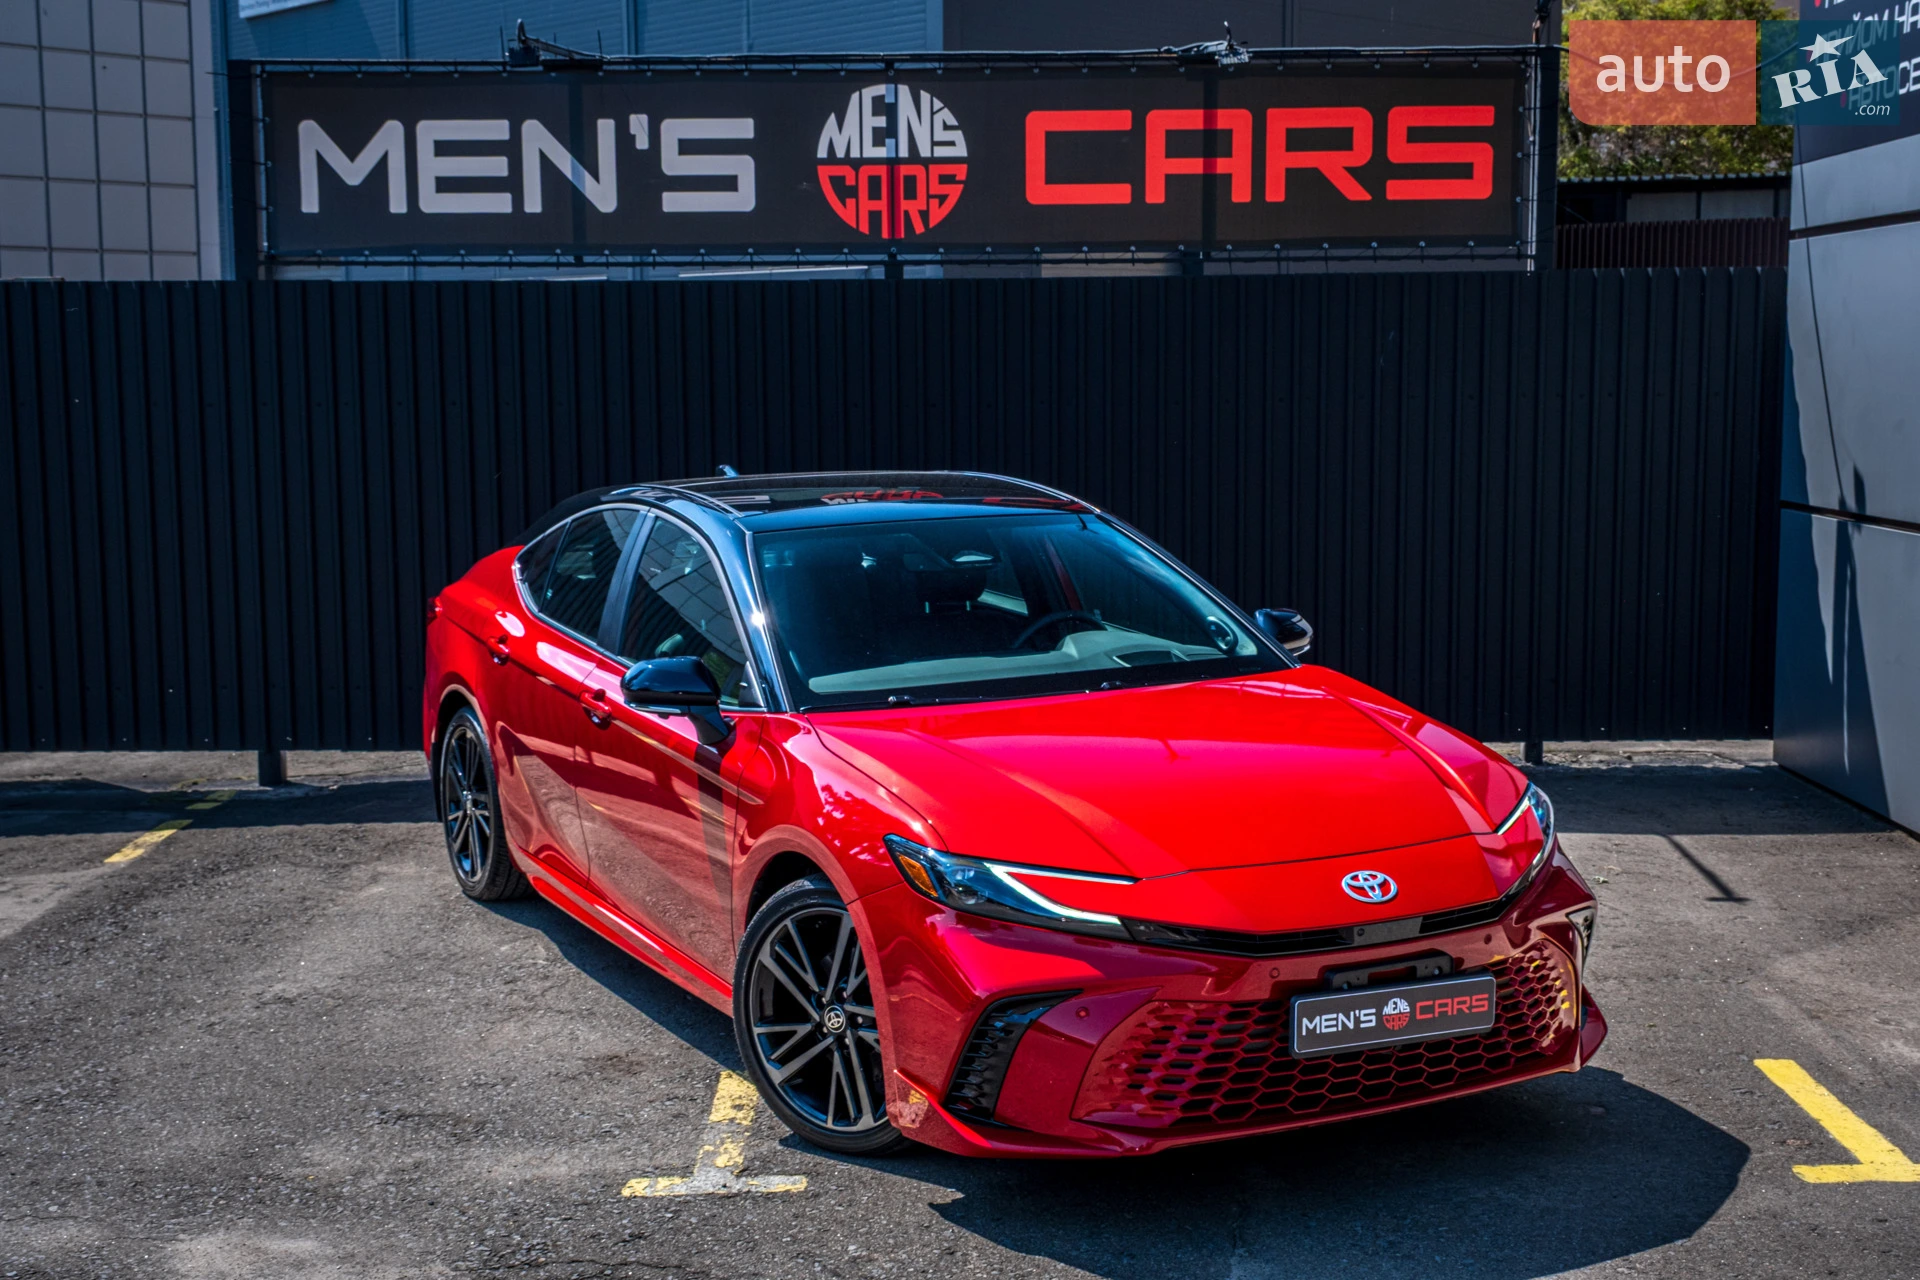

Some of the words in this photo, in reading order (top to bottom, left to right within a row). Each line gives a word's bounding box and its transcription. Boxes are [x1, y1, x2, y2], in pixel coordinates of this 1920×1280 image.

[298, 113, 756, 214] MEN'S
[1025, 105, 1495, 205] CARS
[817, 164, 968, 239] CARS
[1302, 1008, 1376, 1036] MEN'S
[1416, 994, 1489, 1020] CARS
[1383, 1013, 1410, 1030] CARS
